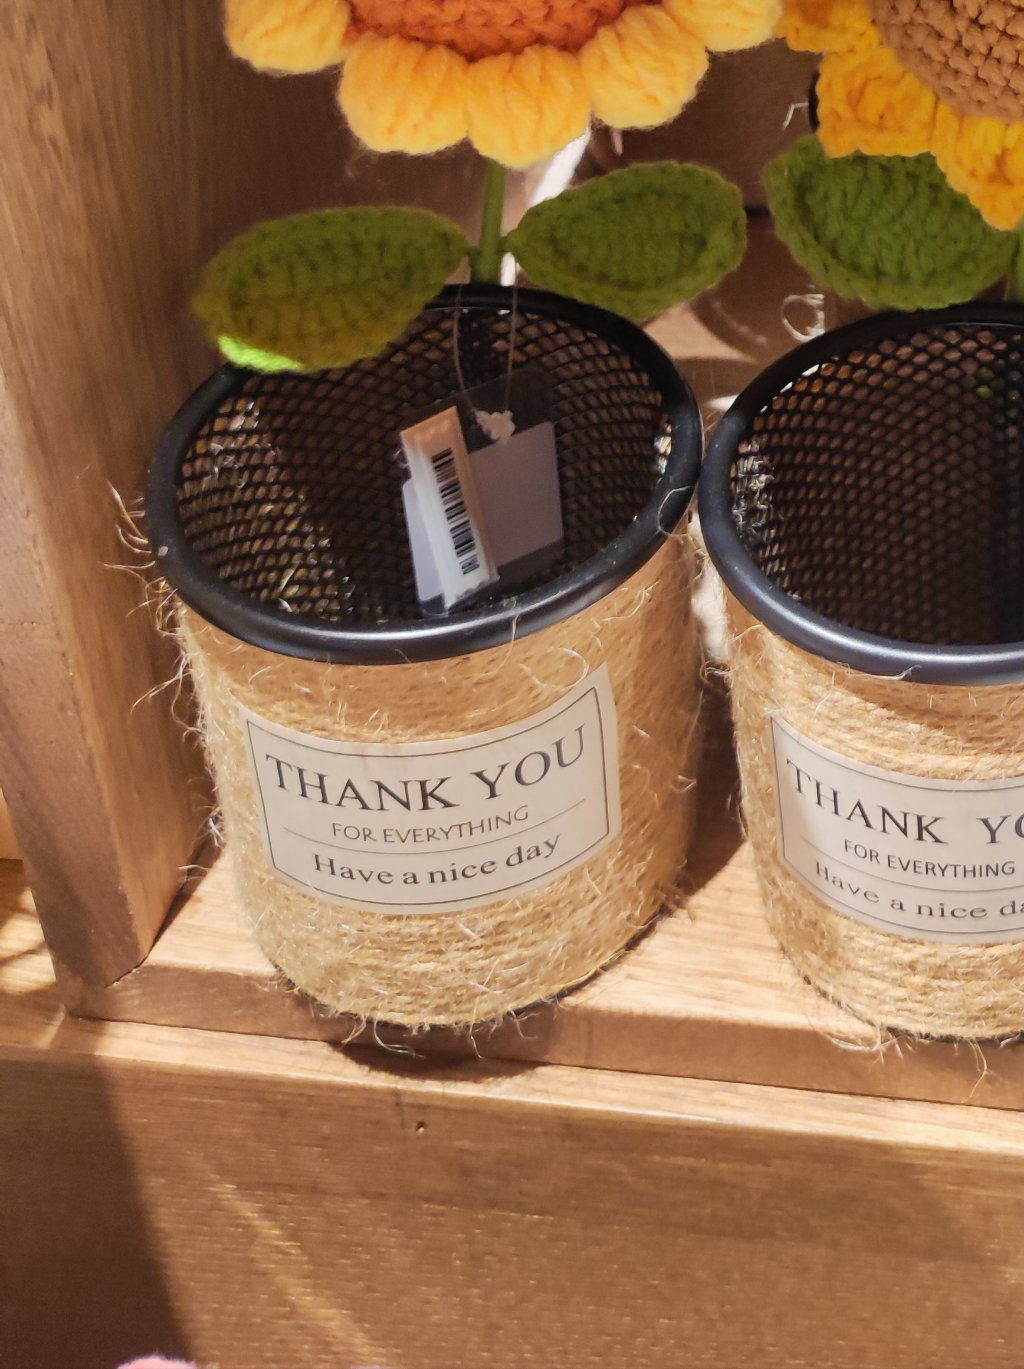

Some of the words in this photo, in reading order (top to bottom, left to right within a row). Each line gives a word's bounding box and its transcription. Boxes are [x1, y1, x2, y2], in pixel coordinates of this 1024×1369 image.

[265, 753, 460, 812] THANK
[470, 724, 586, 799] YOU
[332, 822, 377, 843] FOR
[384, 805, 530, 844] EVERYTHING
[786, 758, 949, 845] THANK
[313, 853, 394, 885] Have
[403, 868, 419, 885] a
[429, 859, 498, 884] nice
[506, 834, 562, 868] day
[844, 839, 880, 865] FOR
[888, 854, 1016, 879] EVERYTHING
[815, 861, 880, 904] Have
[890, 896, 906, 912] a
[915, 901, 987, 919] nice
